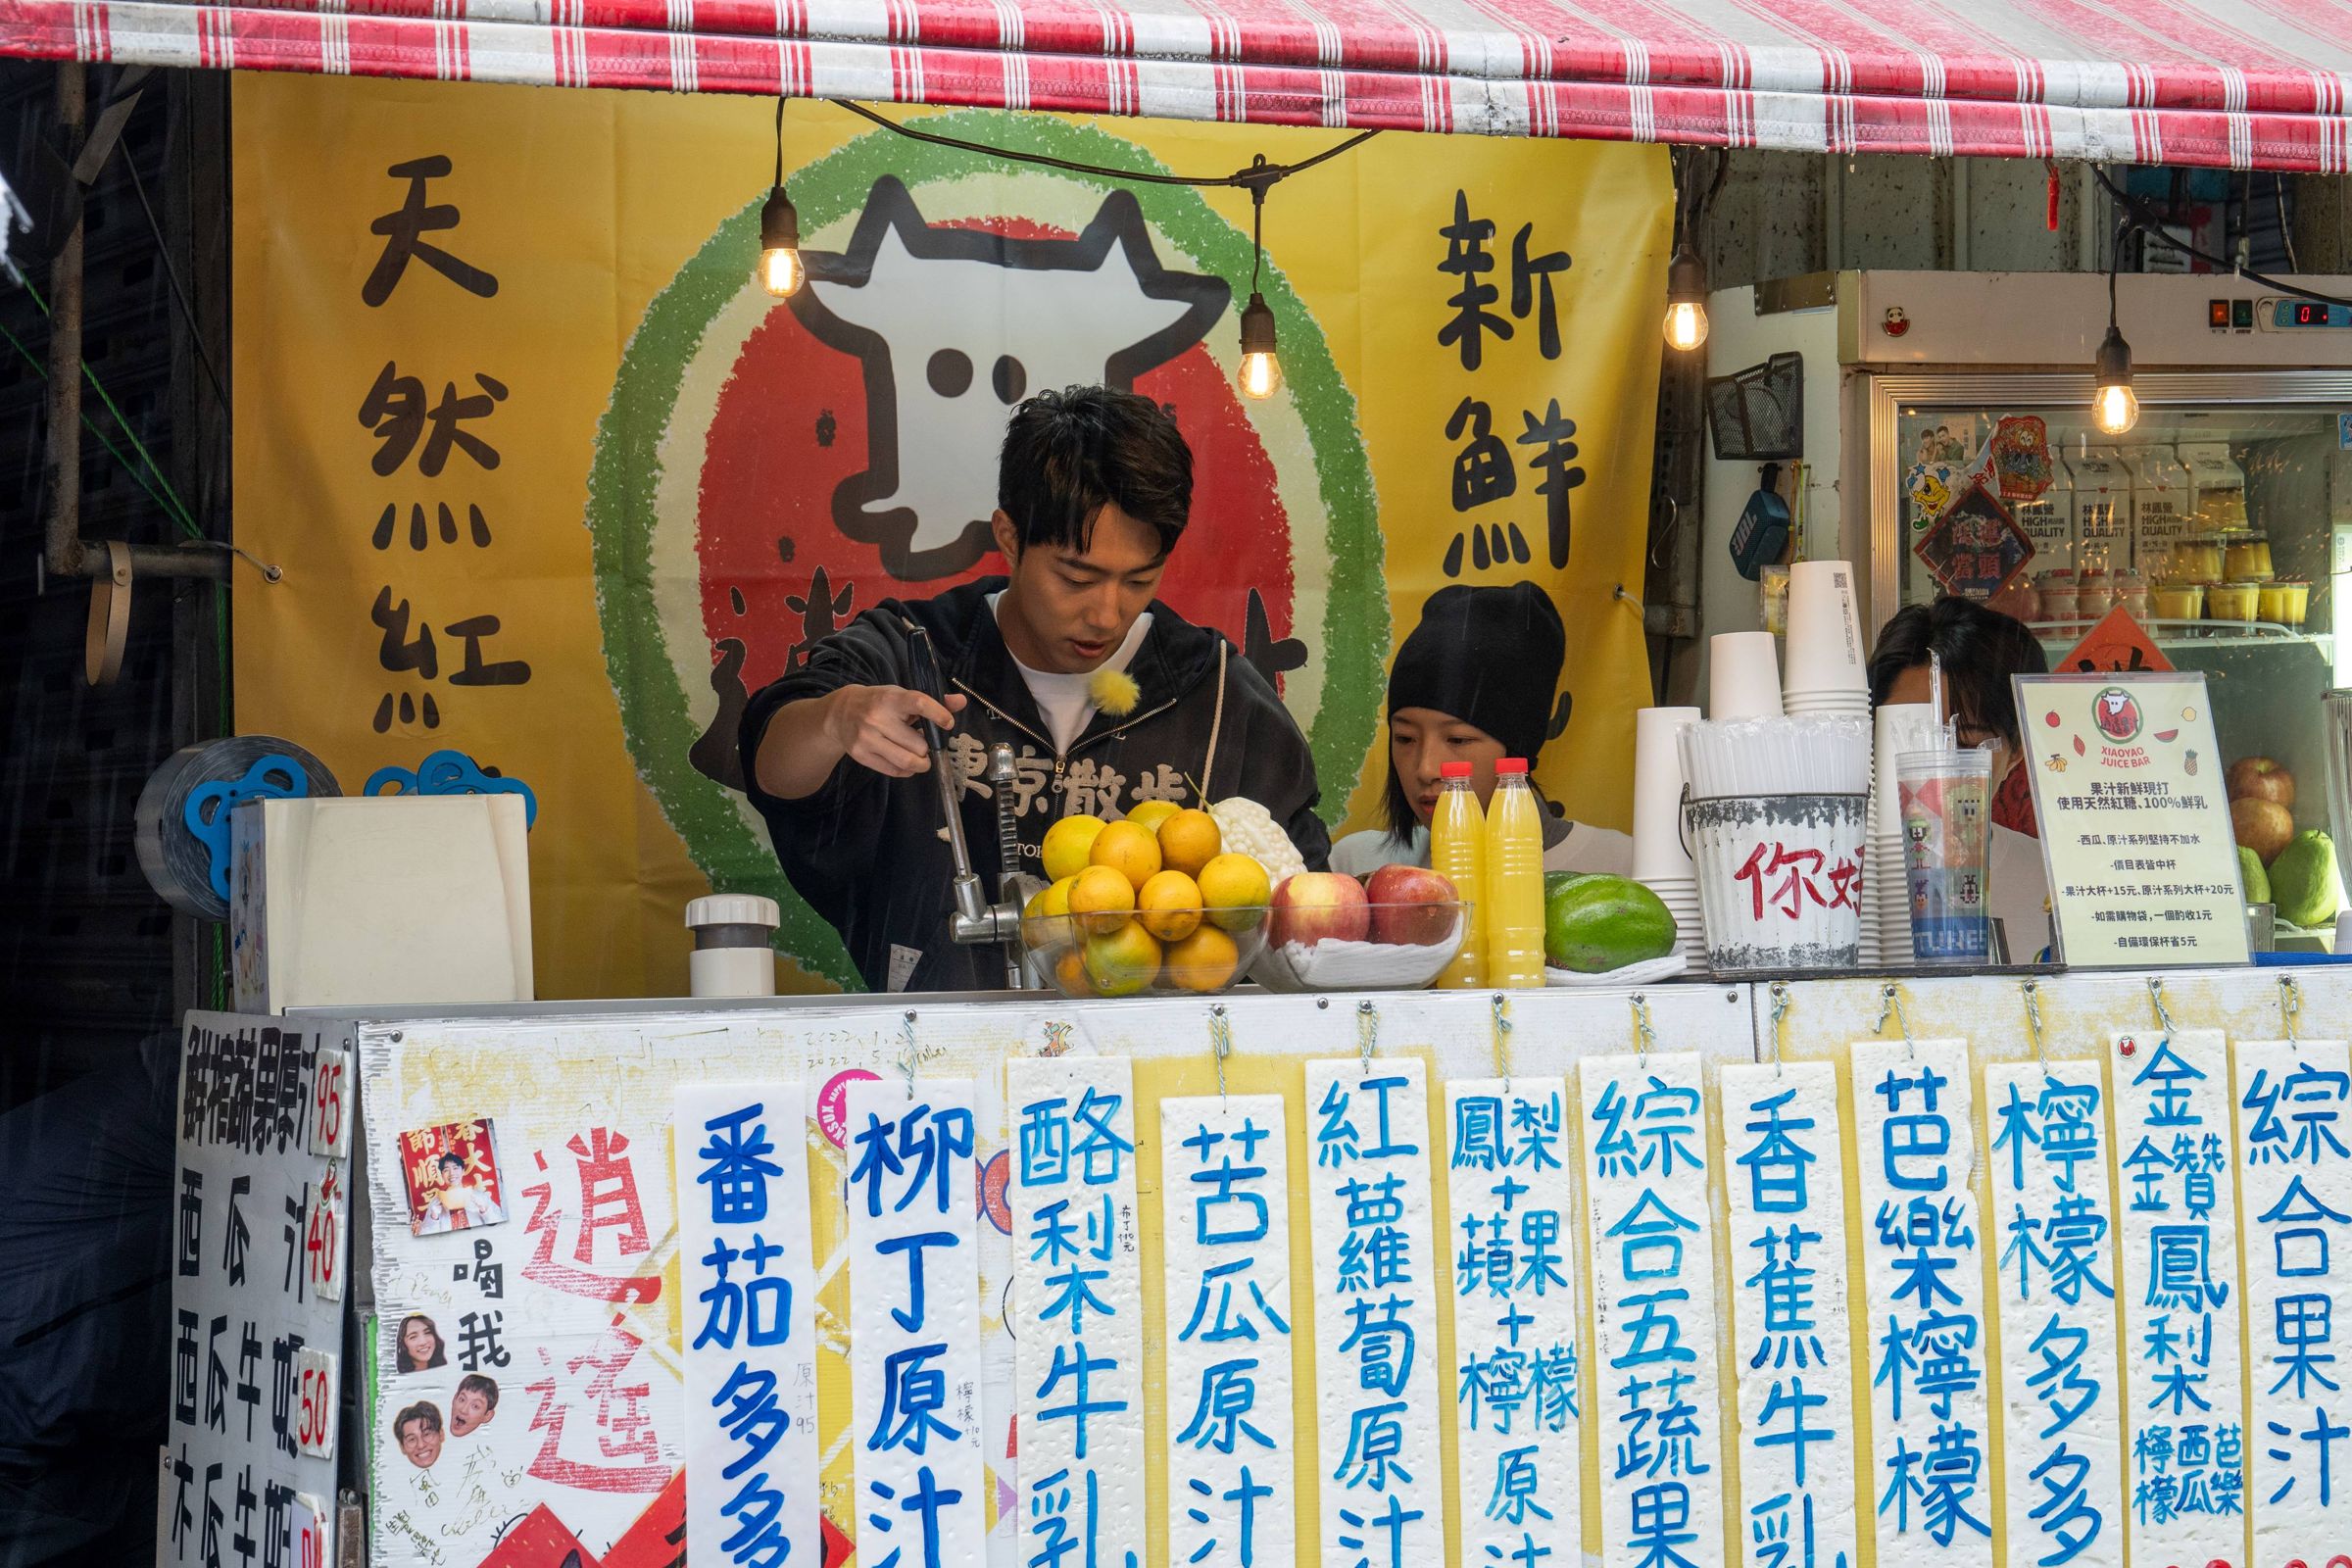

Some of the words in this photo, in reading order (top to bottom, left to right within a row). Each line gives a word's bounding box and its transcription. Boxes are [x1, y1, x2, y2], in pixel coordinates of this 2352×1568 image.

[1438, 189, 1587, 578] 新鮮
[1732, 512, 1758, 556] JBL
[2022, 516, 2047, 526] HIGH
[2024, 527, 2066, 538] QUALITY
[2082, 527, 2125, 538] QUALITY
[2141, 514, 2167, 525] HIGH
[2141, 525, 2182, 537] QUALITY
[2090, 781, 2169, 796] 果汁新鮮現打
[2101, 746, 2144, 759] XIAOYAO
[2101, 757, 2130, 768] JUICE
[2131, 756, 2150, 768] BAR
[1735, 841, 1865, 922] 你好
[318, 1064, 341, 1146] 95
[307, 1205, 334, 1283] 40
[2241, 1061, 2352, 1507] 綜合果汁
[693, 1102, 793, 1568] 番茄多多
[851, 1103, 975, 1568] 柳丁原汁
[1176, 1117, 1291, 1568] 苦瓜原汁
[1317, 1076, 1424, 1568] 紅蘿蔔原汁
[1592, 1075, 1710, 1568] 綜合五蔬果
[1736, 1088, 1848, 1568] 香蕉牛乳
[1874, 1065, 1992, 1548] 芭樂檸檬
[1992, 1076, 2115, 1568] 檸檬多多
[300, 1369, 328, 1446] 50
